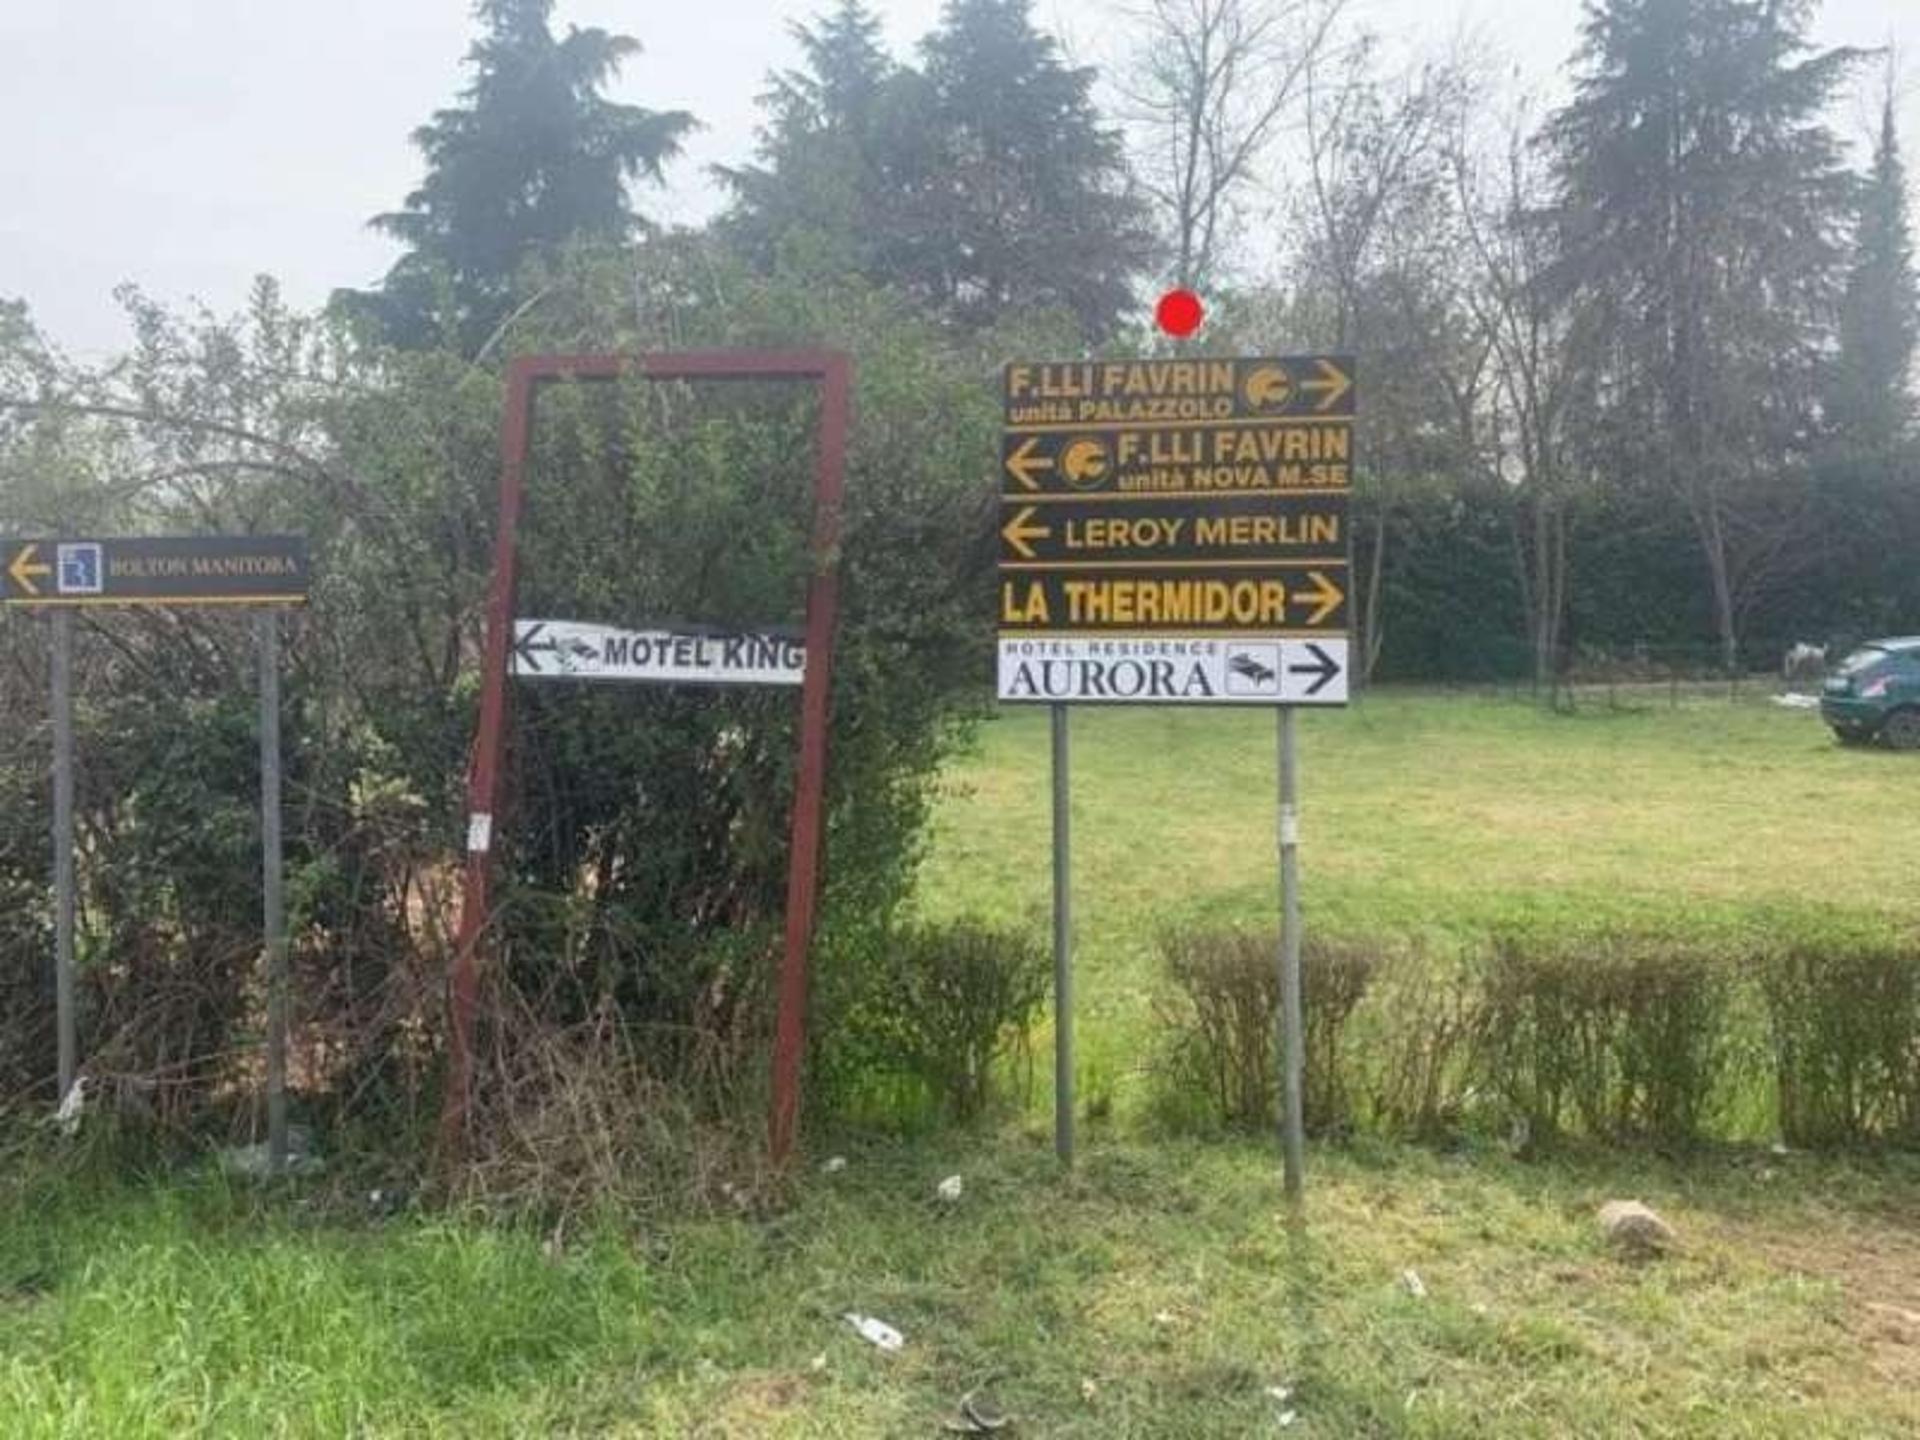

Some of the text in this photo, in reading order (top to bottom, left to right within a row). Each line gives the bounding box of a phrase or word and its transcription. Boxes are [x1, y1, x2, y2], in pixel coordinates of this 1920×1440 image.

[1010, 361, 1233, 397] F.LLI FAVRIN
[1079, 397, 1232, 421] PALAZZOLO
[1118, 428, 1347, 465] F.LLI FAVRIN
[1193, 466, 1269, 488] NOVA
[1066, 515, 1338, 548] LEROY MERLIN
[1003, 581, 1285, 622] LA THERMIDOR
[603, 634, 803, 670] MOTEL KING
[1006, 642, 1217, 656] HOTEL RESIDENCE
[1007, 658, 1215, 697] AURORA
